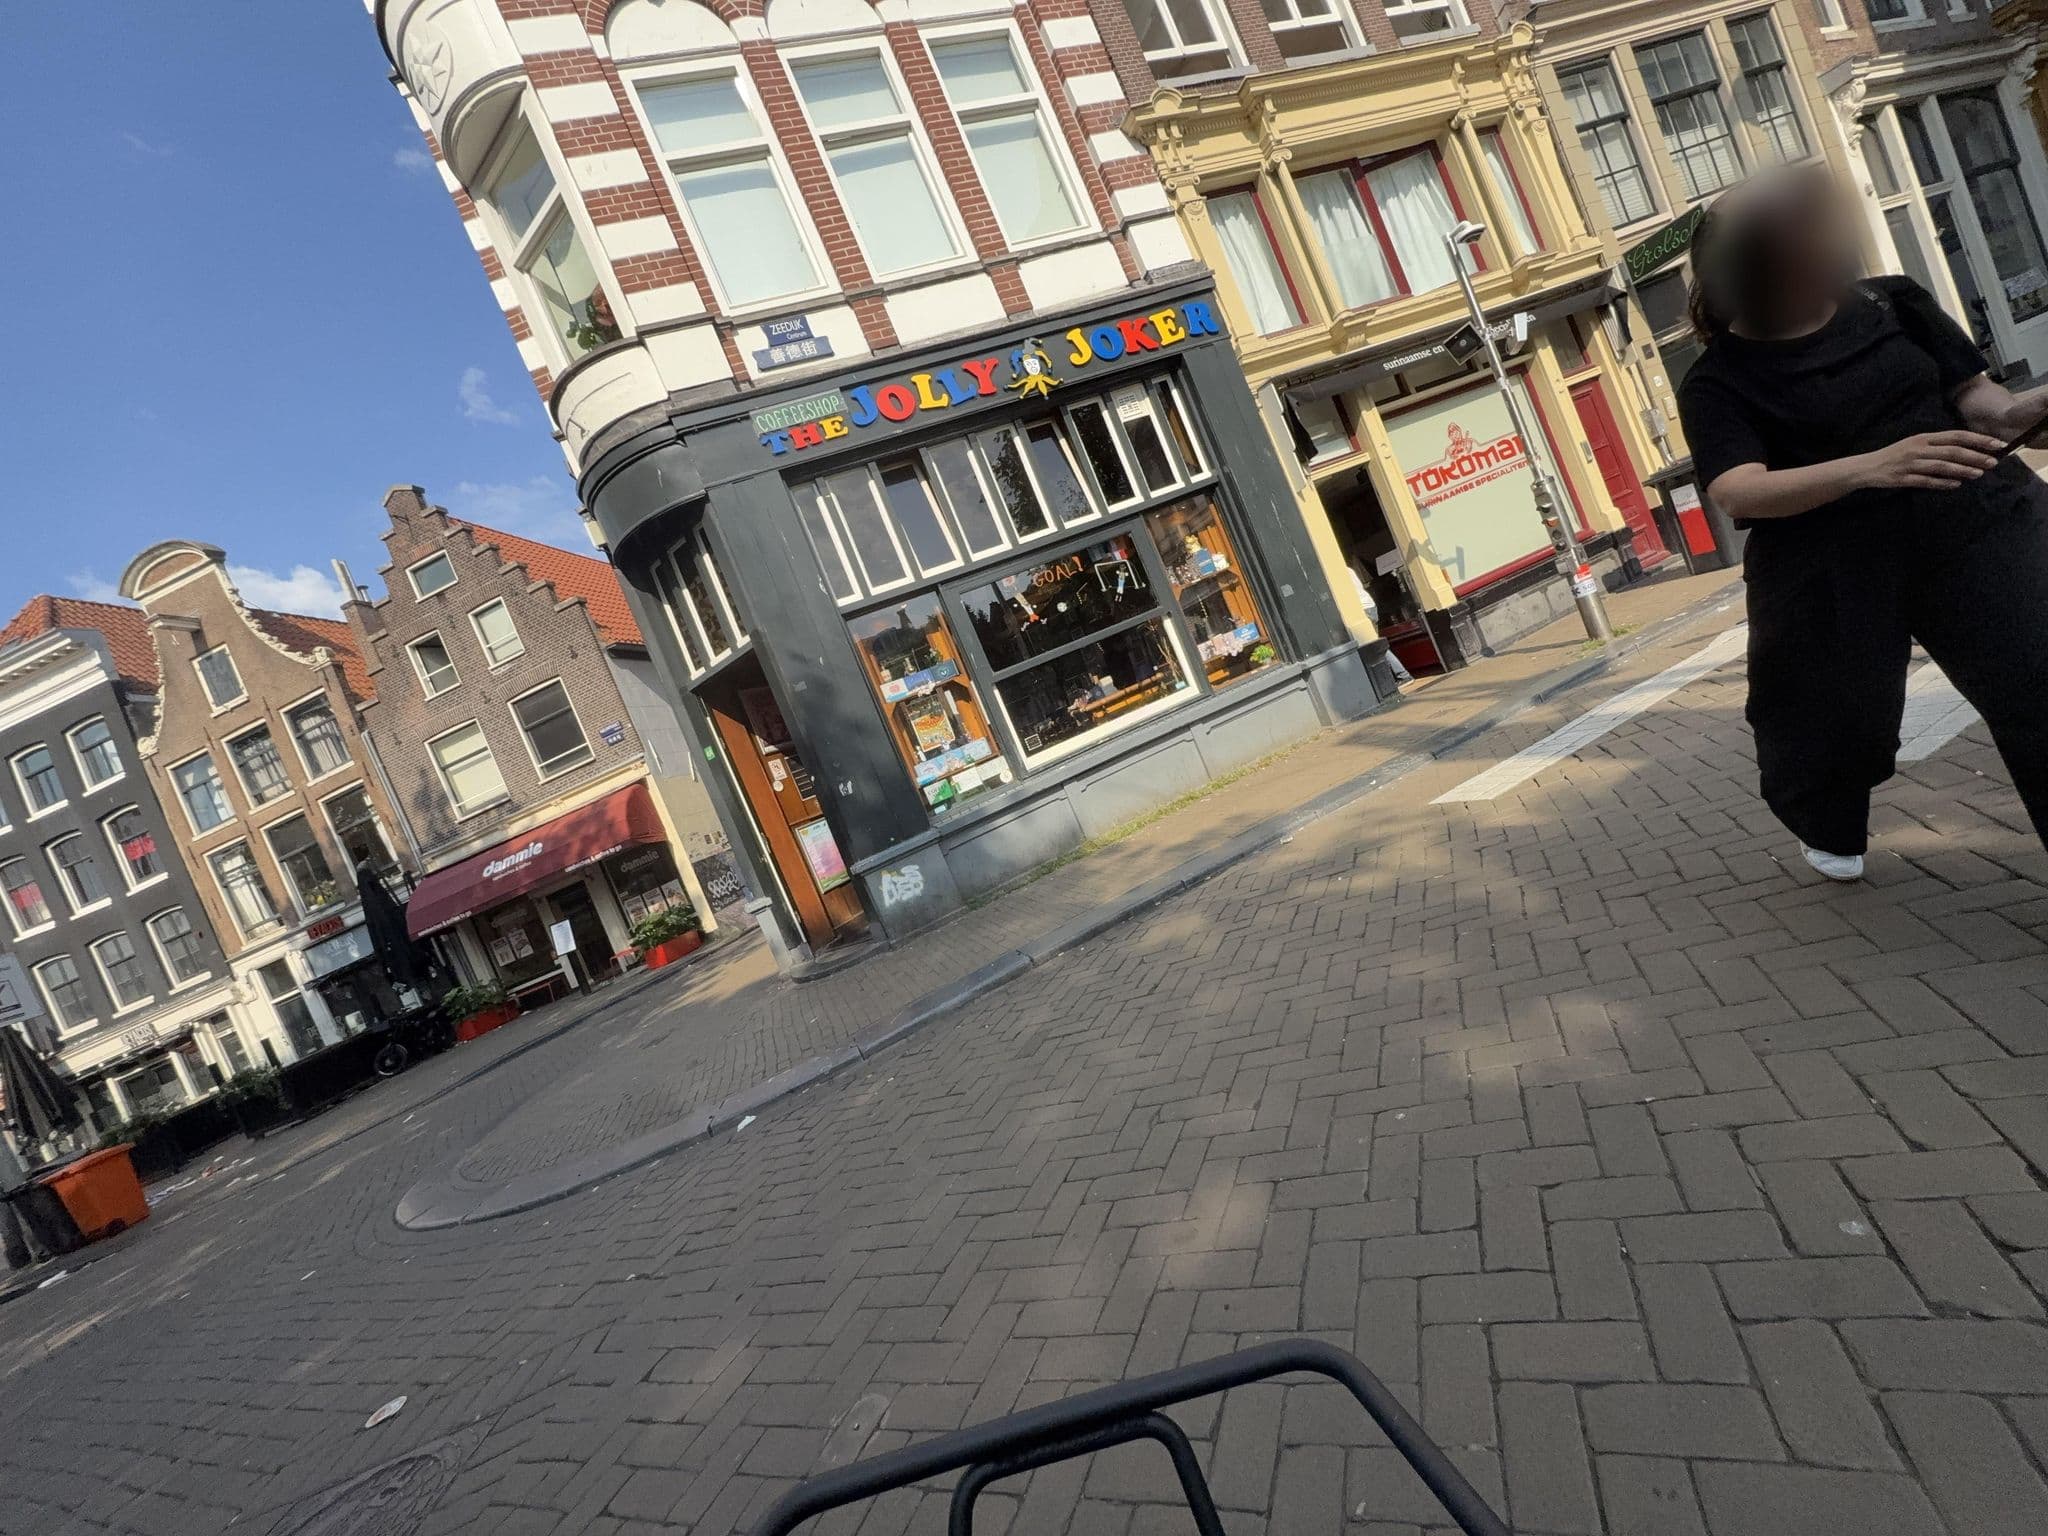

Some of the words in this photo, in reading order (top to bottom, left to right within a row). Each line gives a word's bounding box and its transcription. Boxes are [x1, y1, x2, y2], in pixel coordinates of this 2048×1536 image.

[759, 415, 849, 456] THE
[851, 357, 999, 427] JOLLY
[1066, 303, 1219, 367] JOKER
[756, 395, 840, 432] COFFEESHOP
[1032, 556, 1085, 587] GOAL!
[483, 842, 543, 877] dammie
